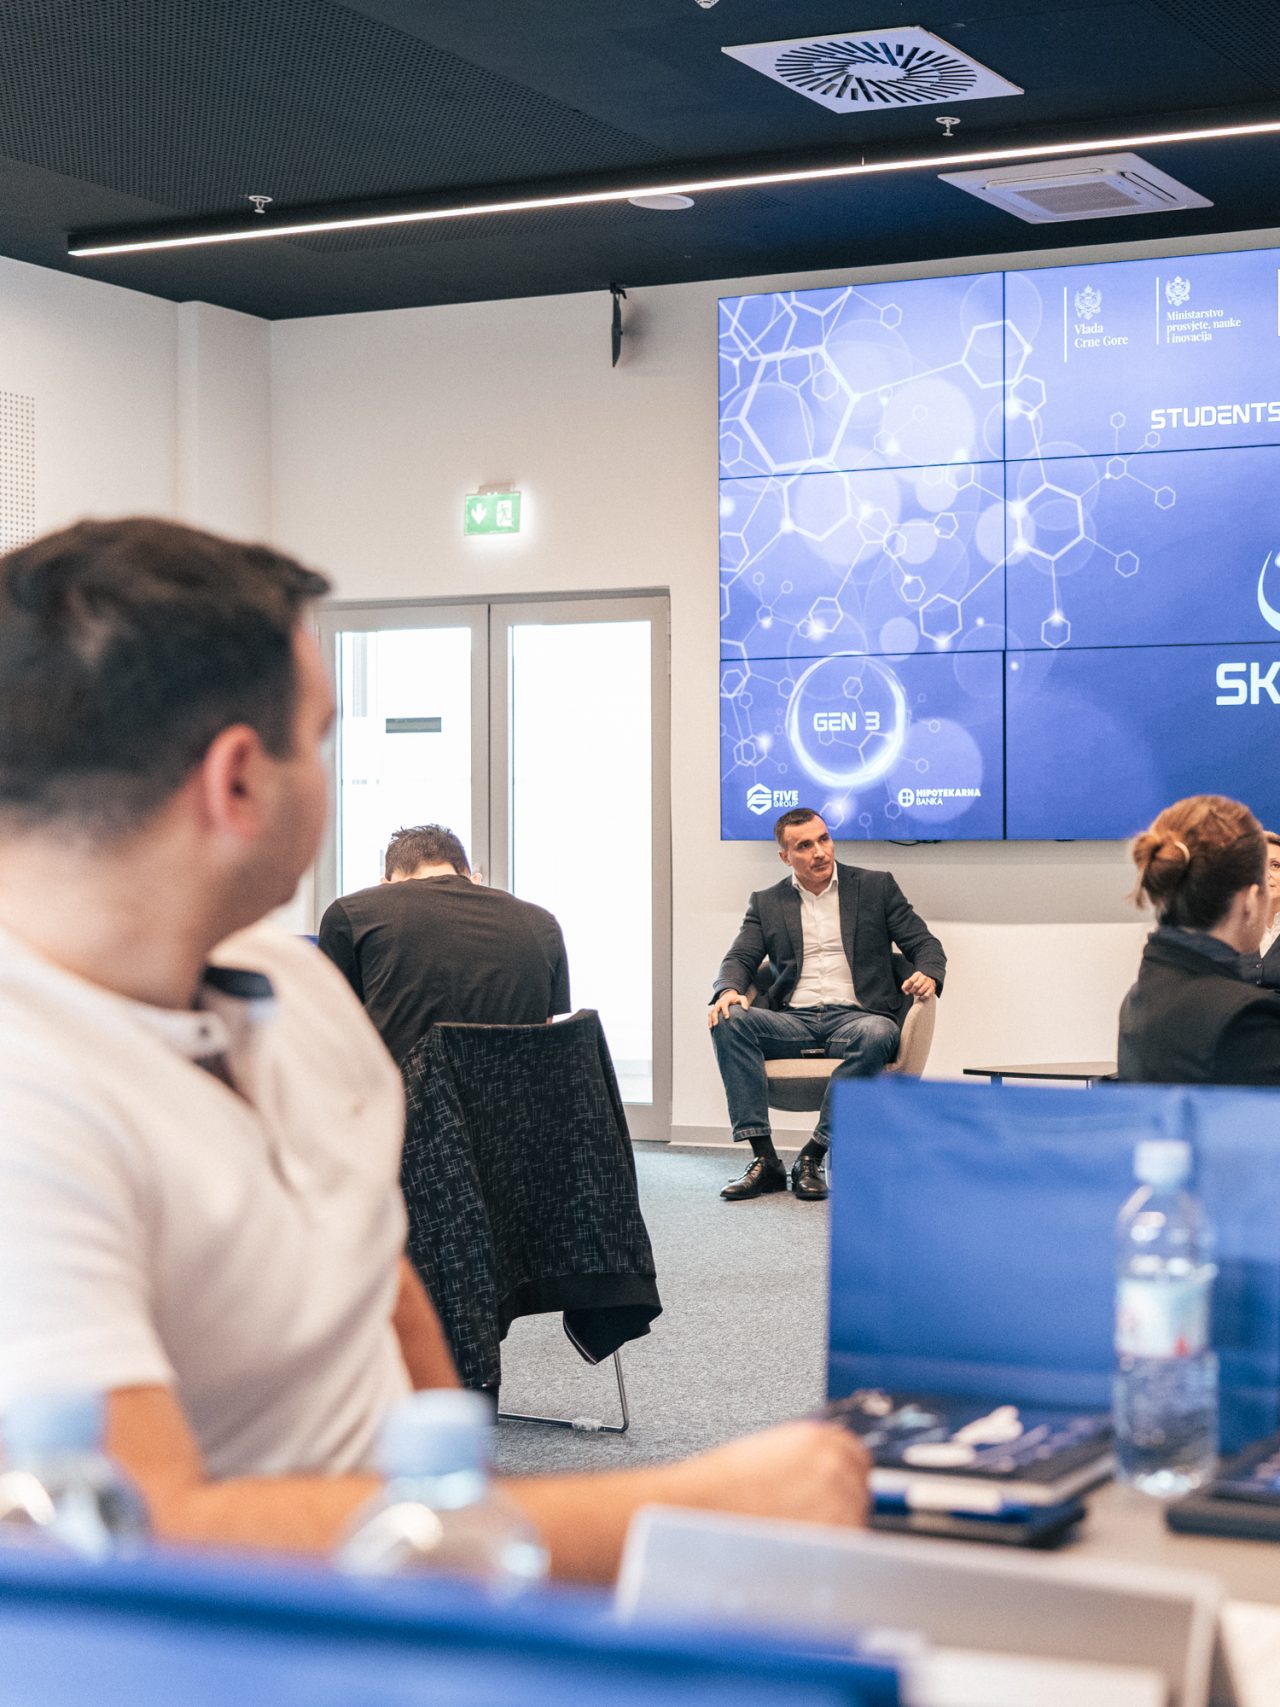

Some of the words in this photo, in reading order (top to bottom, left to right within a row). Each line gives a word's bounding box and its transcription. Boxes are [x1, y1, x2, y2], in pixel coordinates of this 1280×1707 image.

[1166, 308, 1224, 322] Ministarstvo
[1074, 322, 1104, 335] Vlada
[1166, 318, 1211, 333] prosvjete,
[1213, 317, 1242, 330] nauke
[1074, 337, 1101, 349] Crne
[1103, 335, 1129, 347] Gore
[1172, 330, 1213, 344] inovacija
[813, 712, 857, 732] GEN
[865, 712, 880, 731] 3
[773, 790, 799, 800] FIVE
[916, 788, 981, 798] HIPOTEKARNA
[773, 799, 798, 808] GROUP
[916, 797, 943, 806] BANKA
